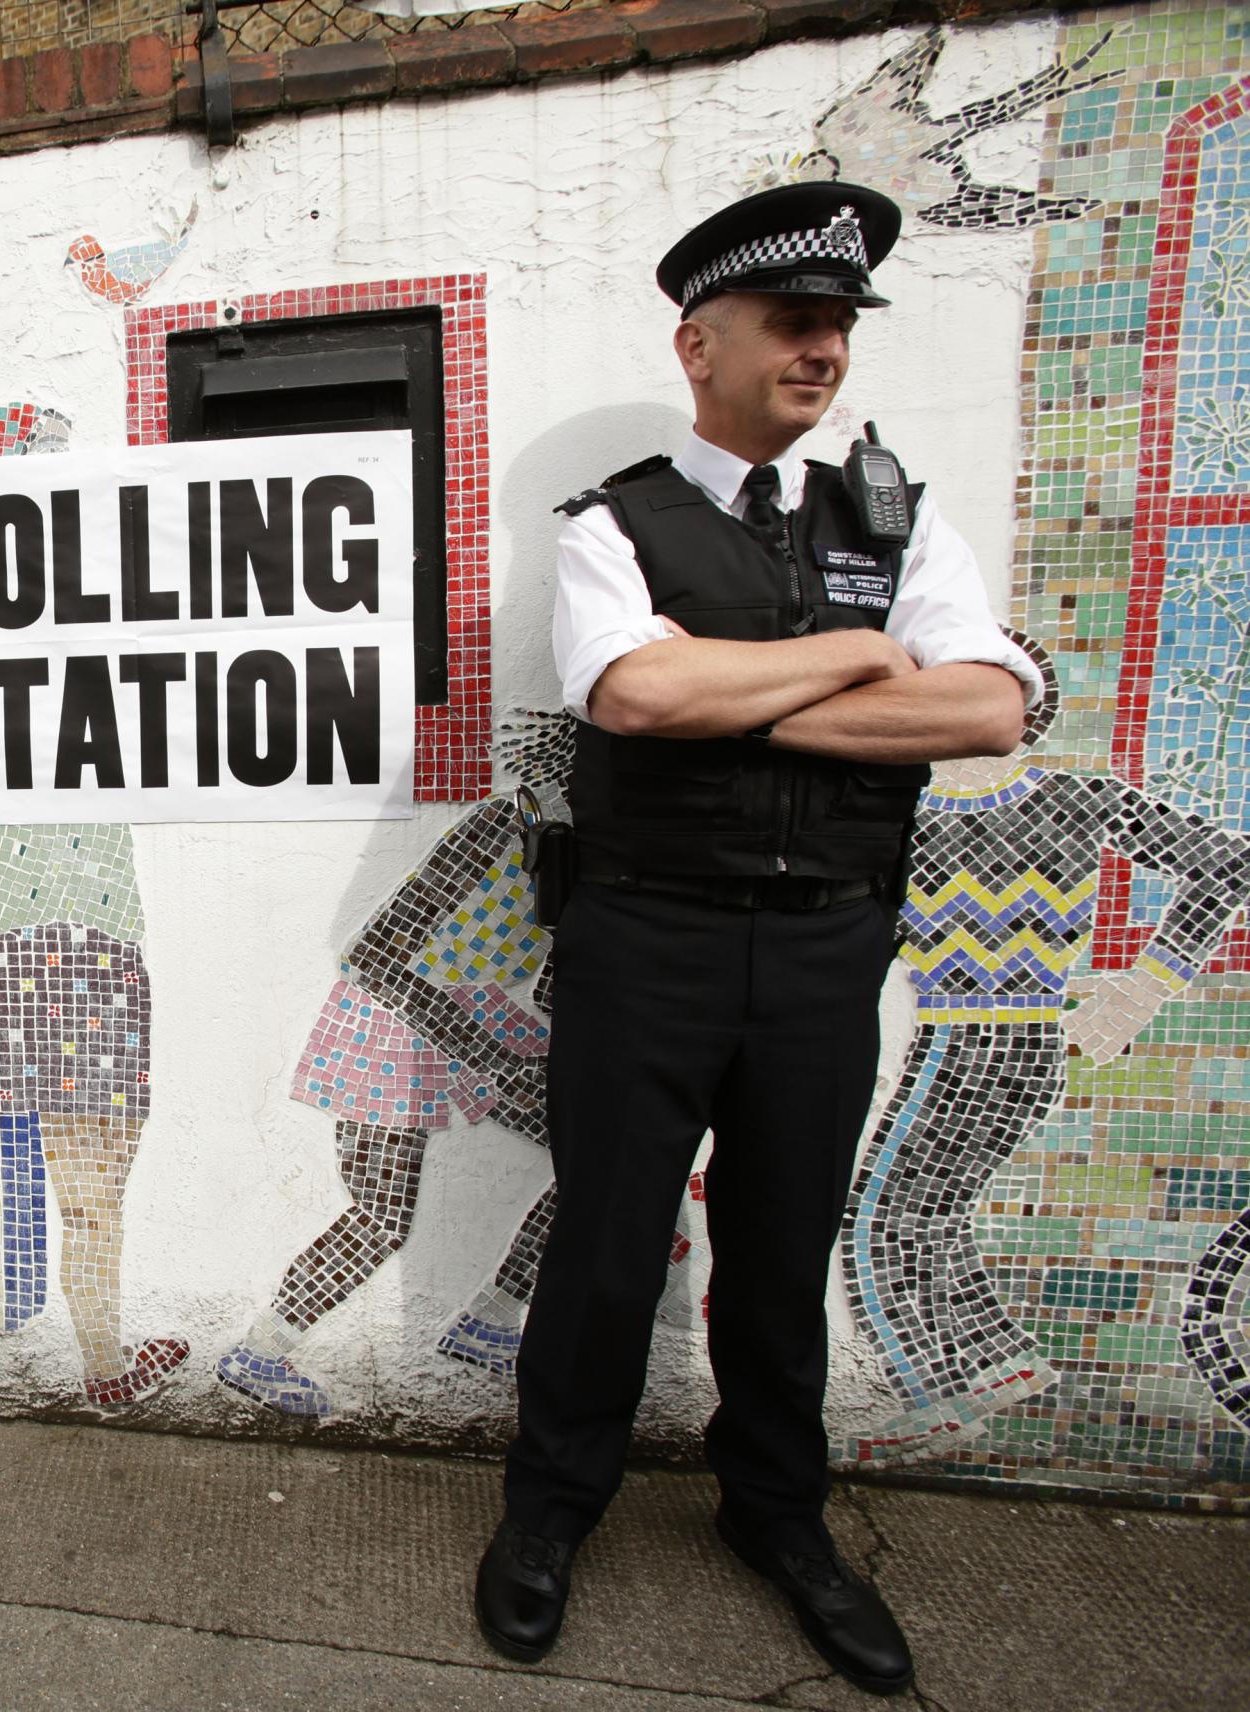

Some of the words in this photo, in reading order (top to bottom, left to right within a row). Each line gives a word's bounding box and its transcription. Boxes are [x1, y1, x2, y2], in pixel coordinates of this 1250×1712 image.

[856, 581, 884, 590] POLICE
[828, 591, 857, 604] POLICE
[857, 594, 890, 608] OFFICER
